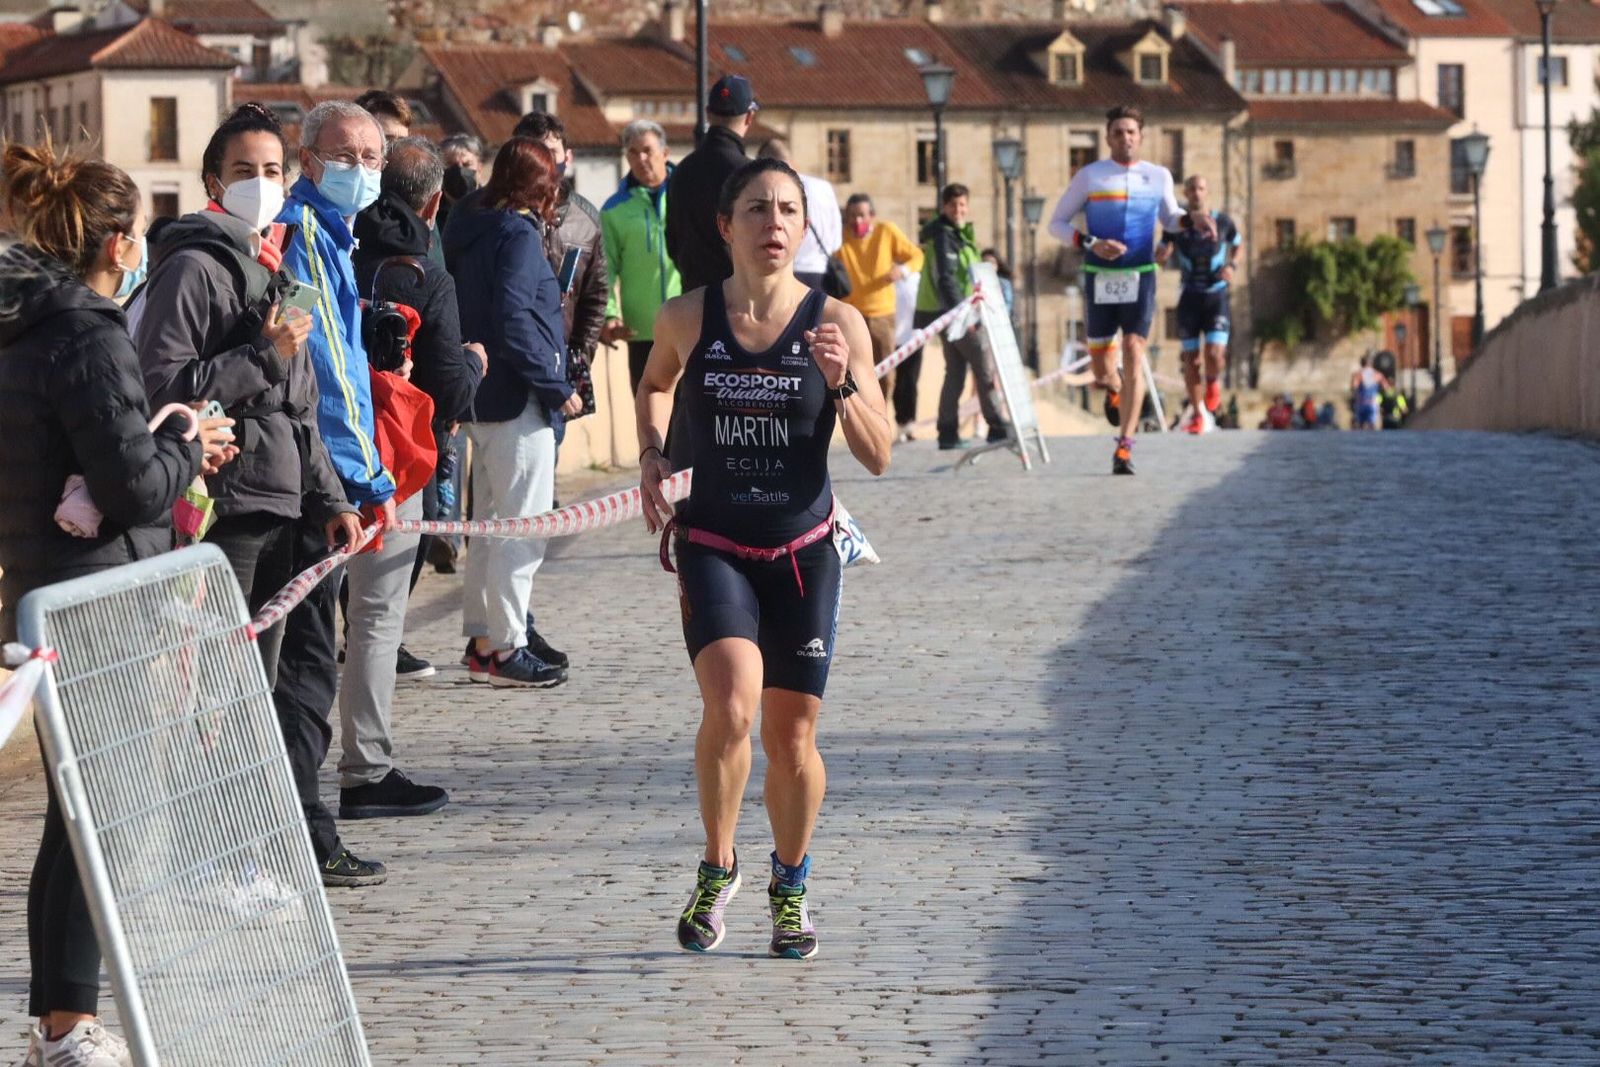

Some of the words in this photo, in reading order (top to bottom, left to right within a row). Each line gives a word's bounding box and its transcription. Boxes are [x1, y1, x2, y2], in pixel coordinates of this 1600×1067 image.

[1105, 281, 1128, 295] 625
[703, 373, 802, 391] ECOSPORT
[716, 386, 789, 402] triatlón
[715, 412, 790, 448] MARTÍN
[726, 457, 785, 471] ECIJA
